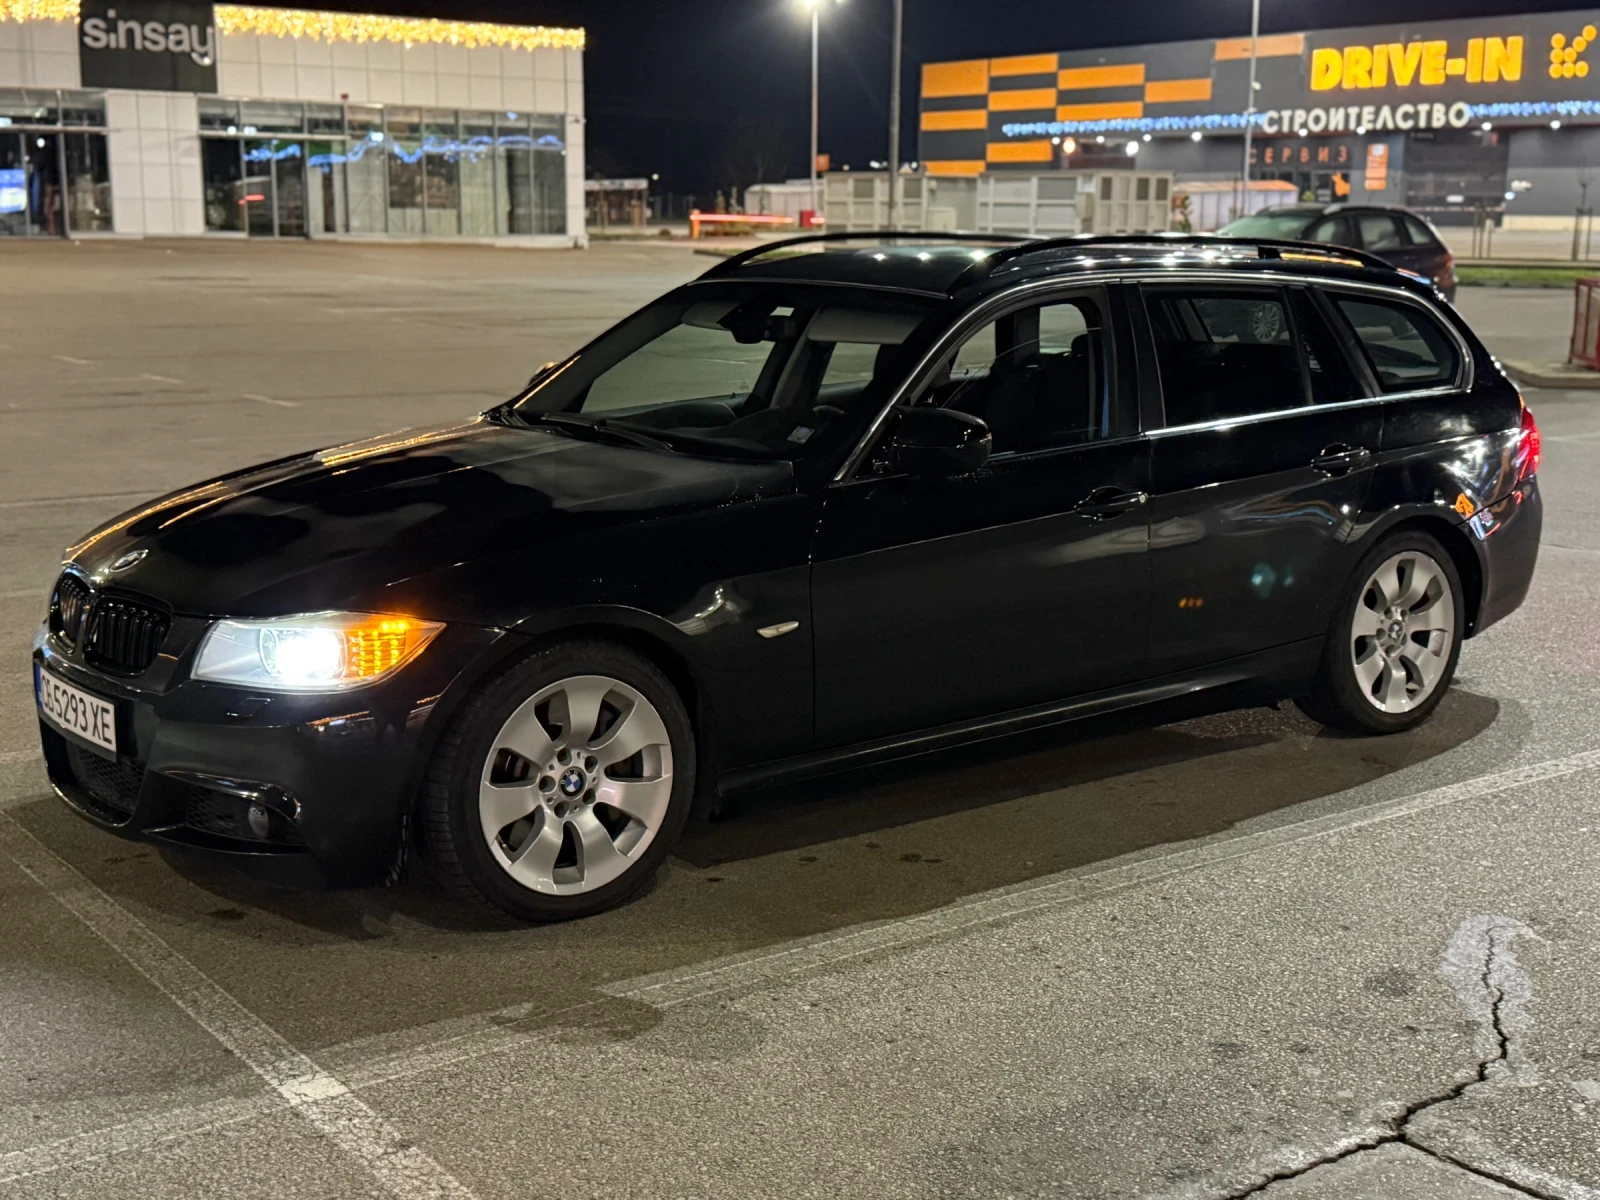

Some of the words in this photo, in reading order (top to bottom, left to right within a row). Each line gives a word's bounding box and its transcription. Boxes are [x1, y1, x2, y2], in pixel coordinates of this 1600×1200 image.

[82, 8, 215, 66] sinsay
[1310, 35, 1524, 91] DRIVE-IN
[1262, 101, 1471, 134] СТРОИТЕЛСТВО
